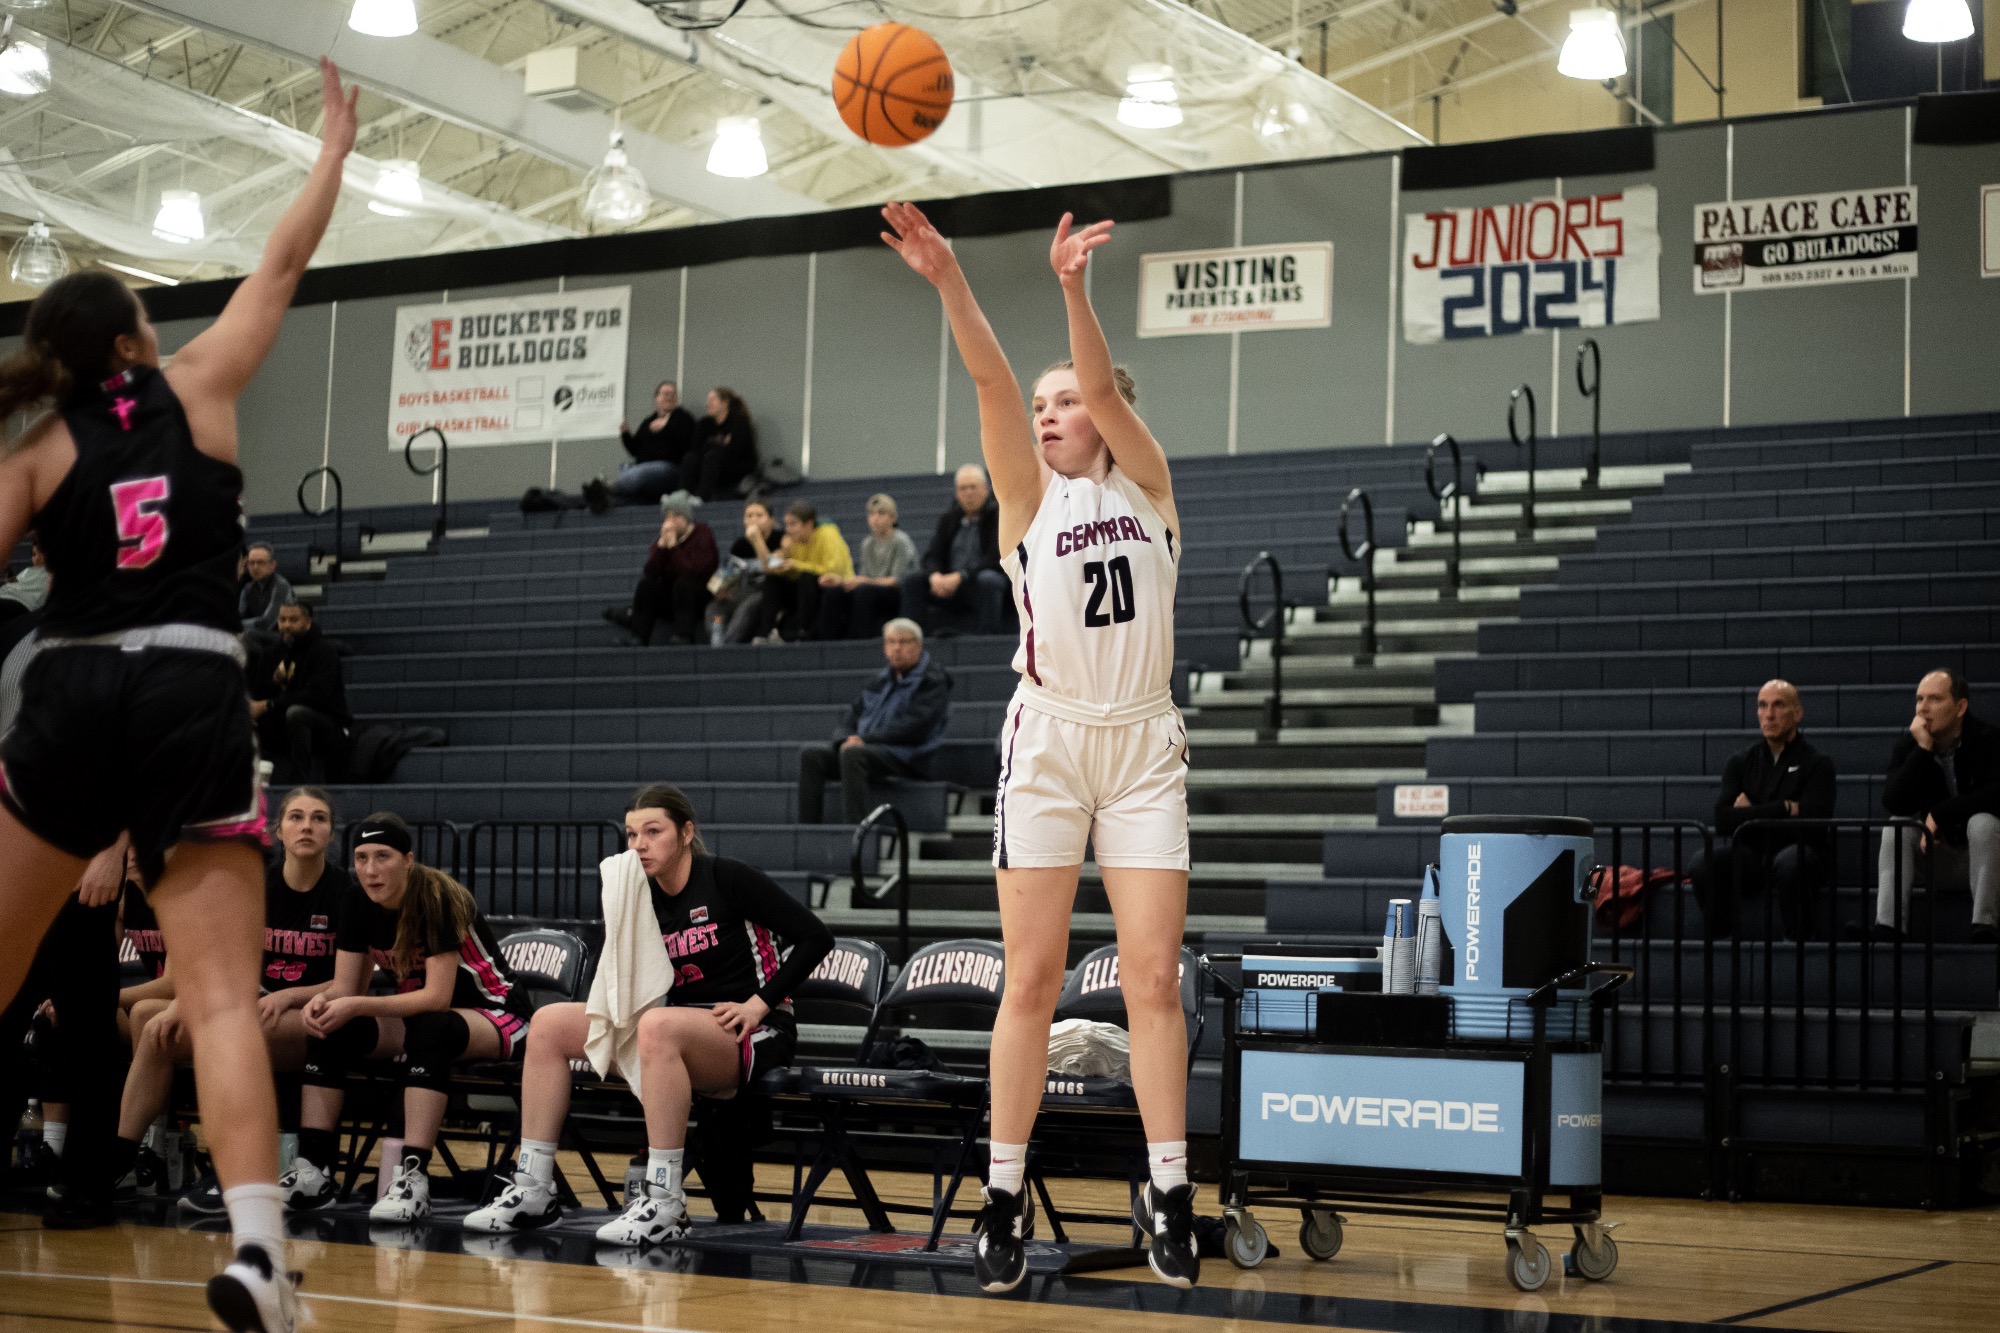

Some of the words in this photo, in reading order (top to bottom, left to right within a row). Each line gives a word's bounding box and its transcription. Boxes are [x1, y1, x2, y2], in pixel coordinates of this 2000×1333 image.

[1413, 192, 1624, 271] JUNIORS
[1702, 200, 1819, 239] PALACE
[1830, 191, 1911, 228] CAFE
[1762, 245, 1789, 265] GO
[1792, 231, 1900, 262] BULLDOGS!
[1174, 255, 1296, 290] VISITING
[1166, 289, 1238, 309] PARENTS
[1261, 285, 1303, 303] FANS
[1440, 258, 1616, 340] 2024
[459, 307, 577, 340] BUCKETS
[583, 307, 621, 330] FOR
[430, 319, 452, 370] E
[457, 336, 588, 369] BULLDOGS
[398, 392, 430, 407] BOYS
[433, 386, 509, 405] BASKETBALL
[109, 475, 170, 569] 5
[1056, 516, 1152, 557] CENTRAL
[1084, 555, 1136, 628] 20
[1465, 843, 1482, 981] POWERADE
[906, 950, 1003, 993] ELLENSBURG
[1258, 973, 1336, 987] POWERADE
[823, 1072, 886, 1087] BULLDOGS
[1262, 1092, 1499, 1132] POWERADE
